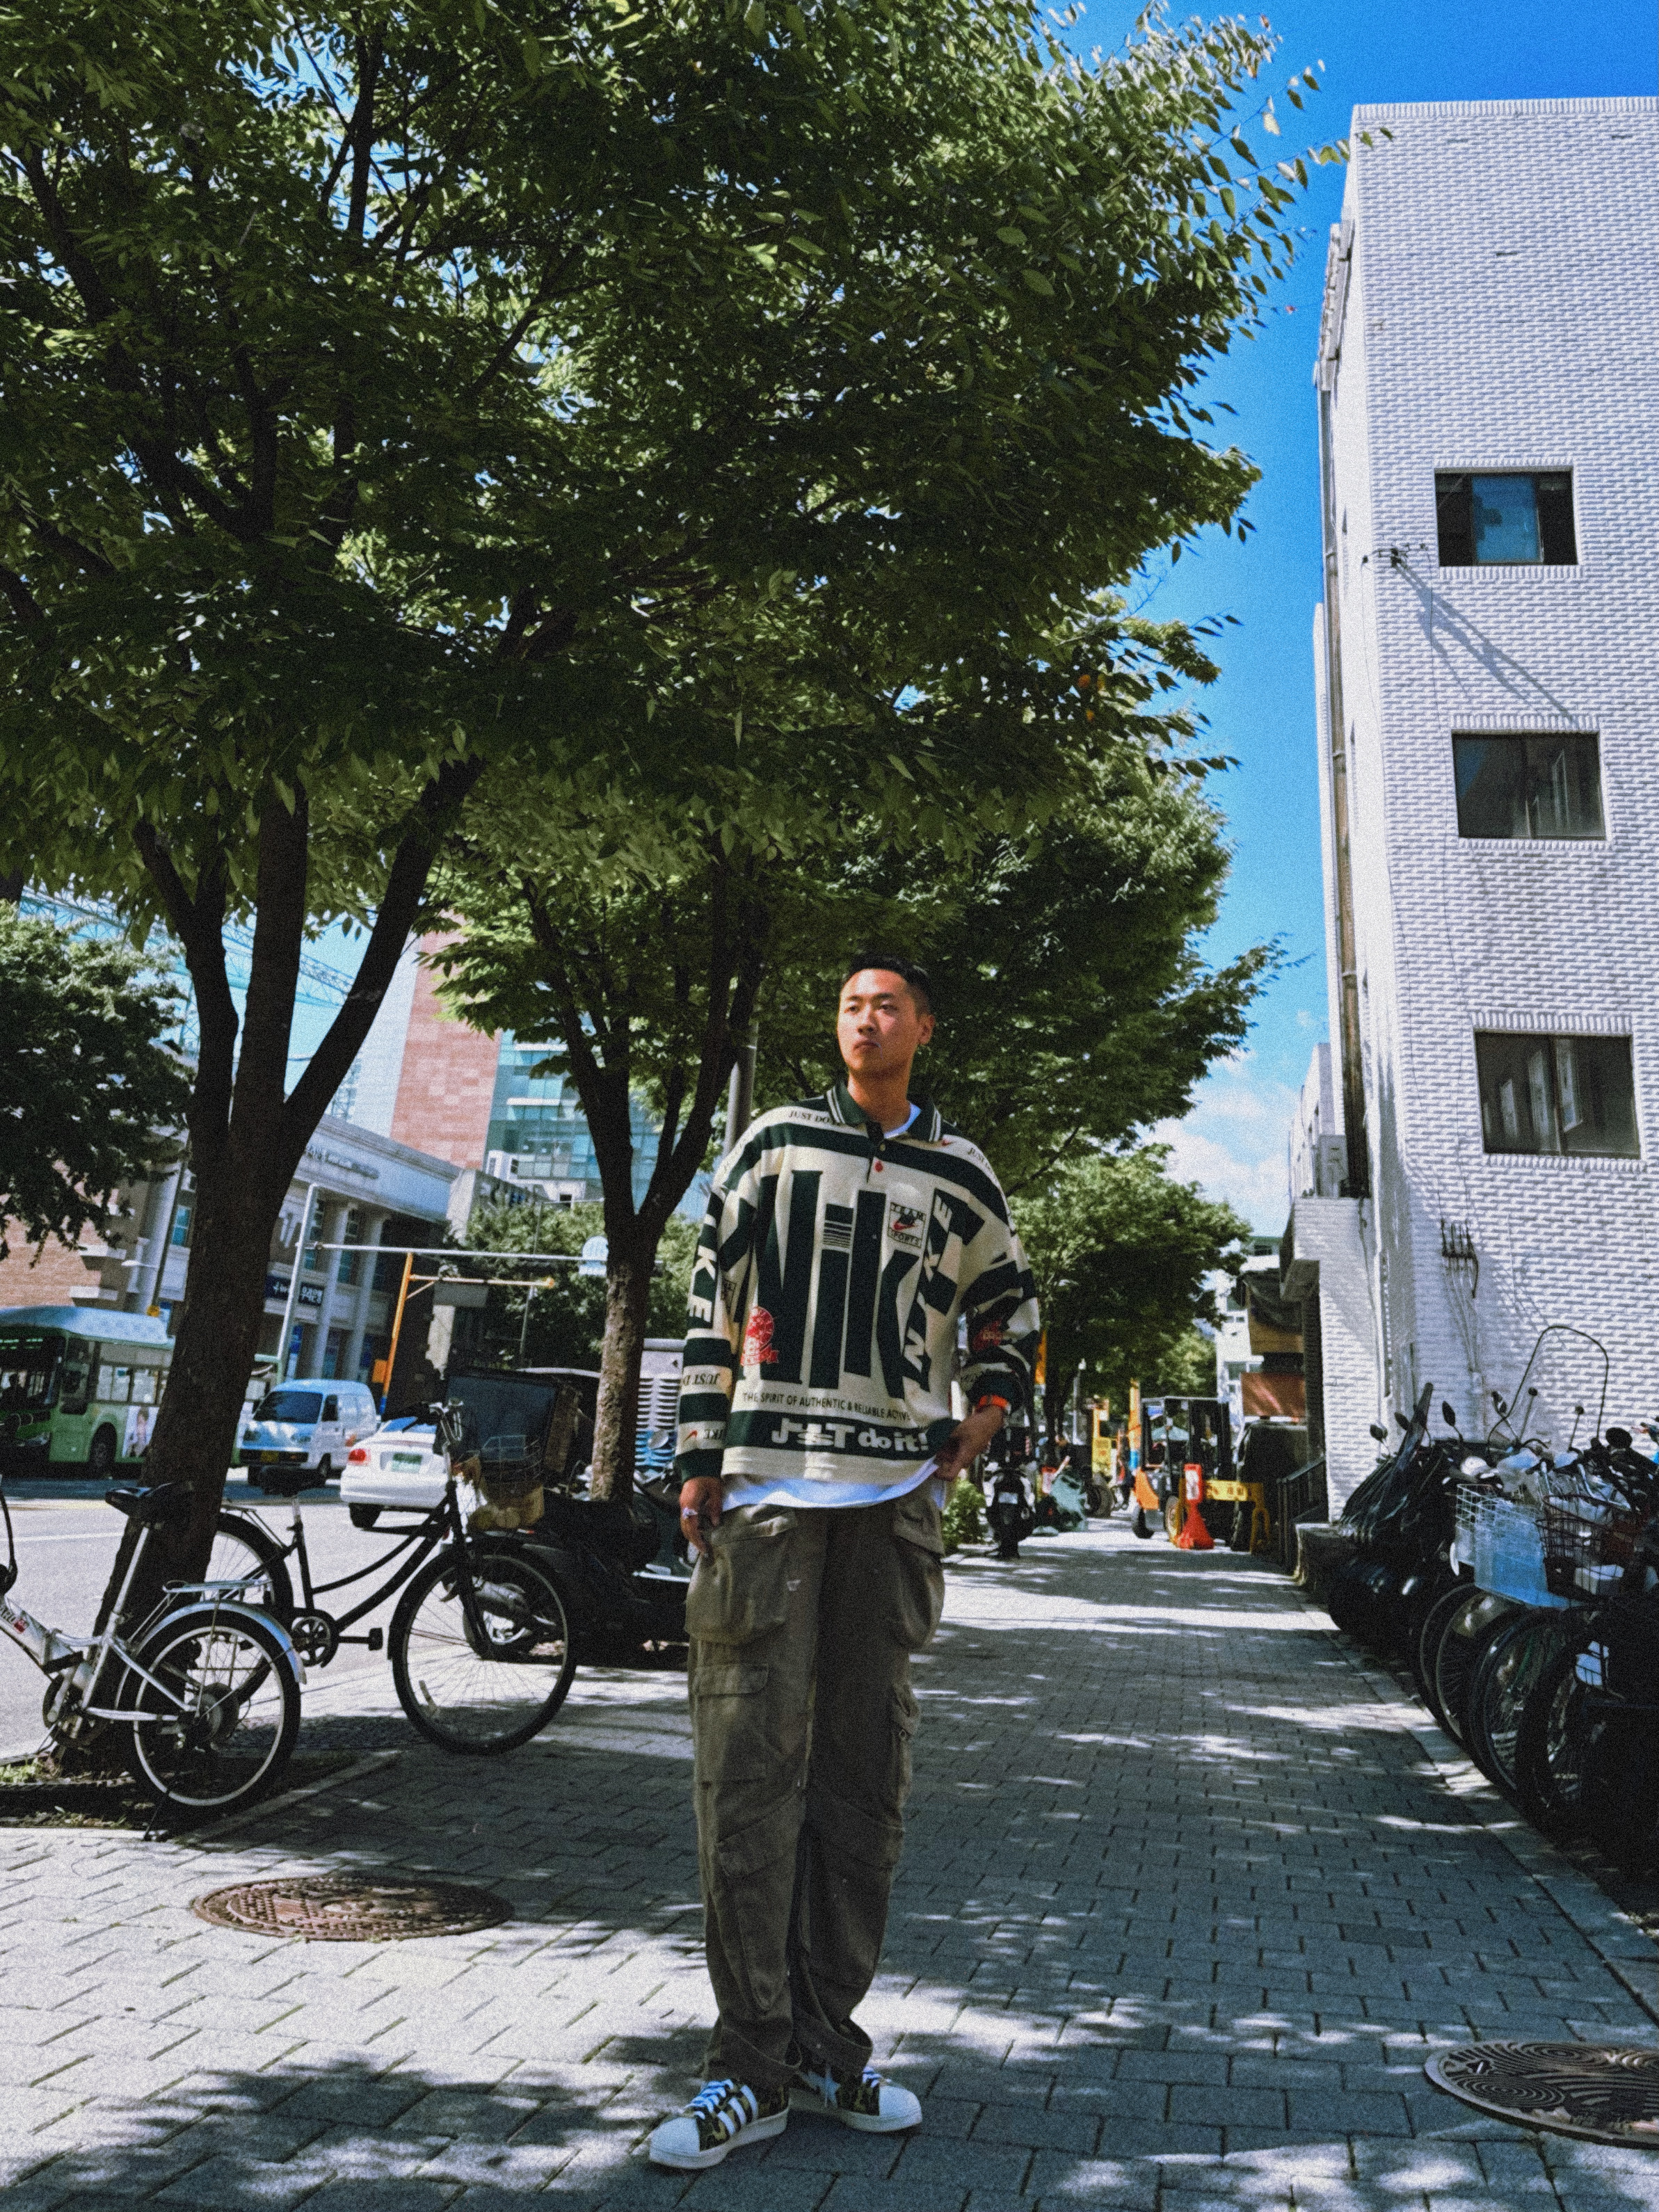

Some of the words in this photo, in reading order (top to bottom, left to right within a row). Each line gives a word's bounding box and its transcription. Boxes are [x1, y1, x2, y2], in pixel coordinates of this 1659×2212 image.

[742, 1393, 758, 1403] THE
[760, 1393, 784, 1404] SPIRIT
[786, 1395, 798, 1405] OF
[799, 1396, 845, 1410] AUTHENTIC
